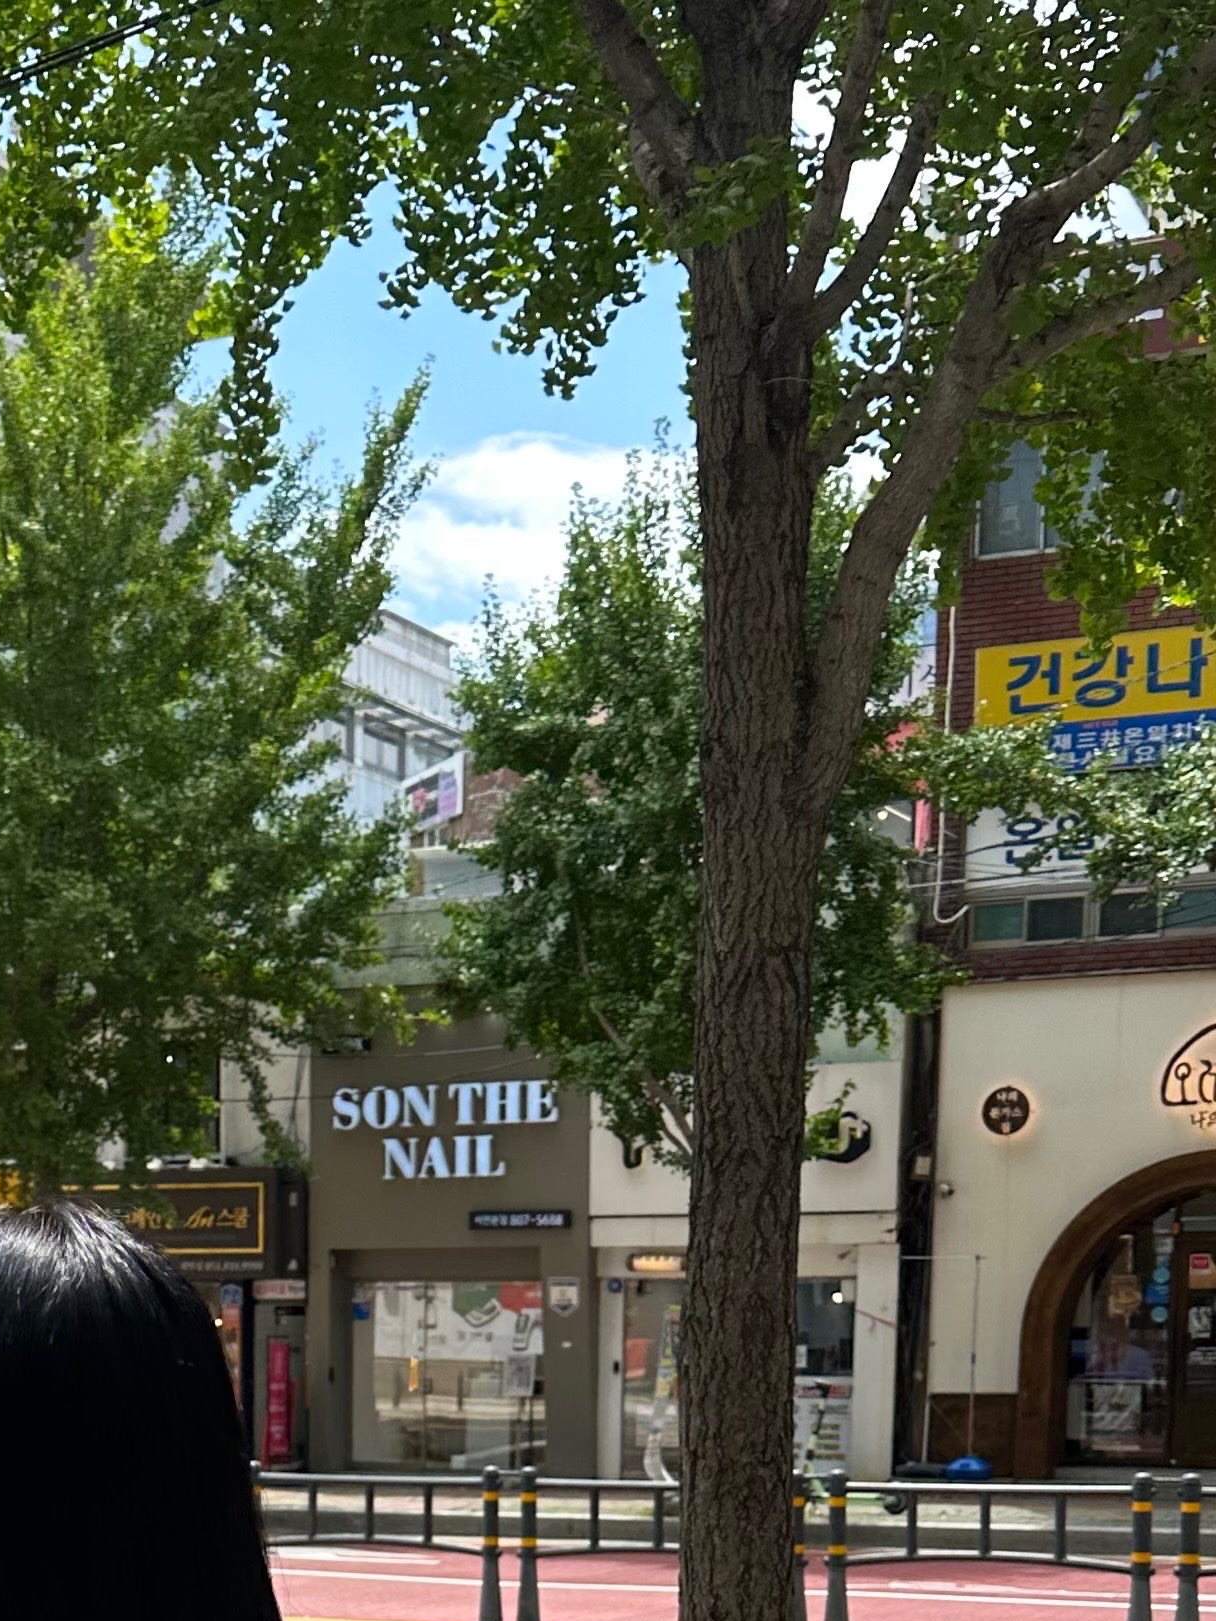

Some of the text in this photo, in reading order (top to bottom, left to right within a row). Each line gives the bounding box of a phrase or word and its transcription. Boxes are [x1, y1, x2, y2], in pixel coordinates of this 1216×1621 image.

[332, 1079, 559, 1131] SON THE
[382, 1134, 506, 1180] NAIL
